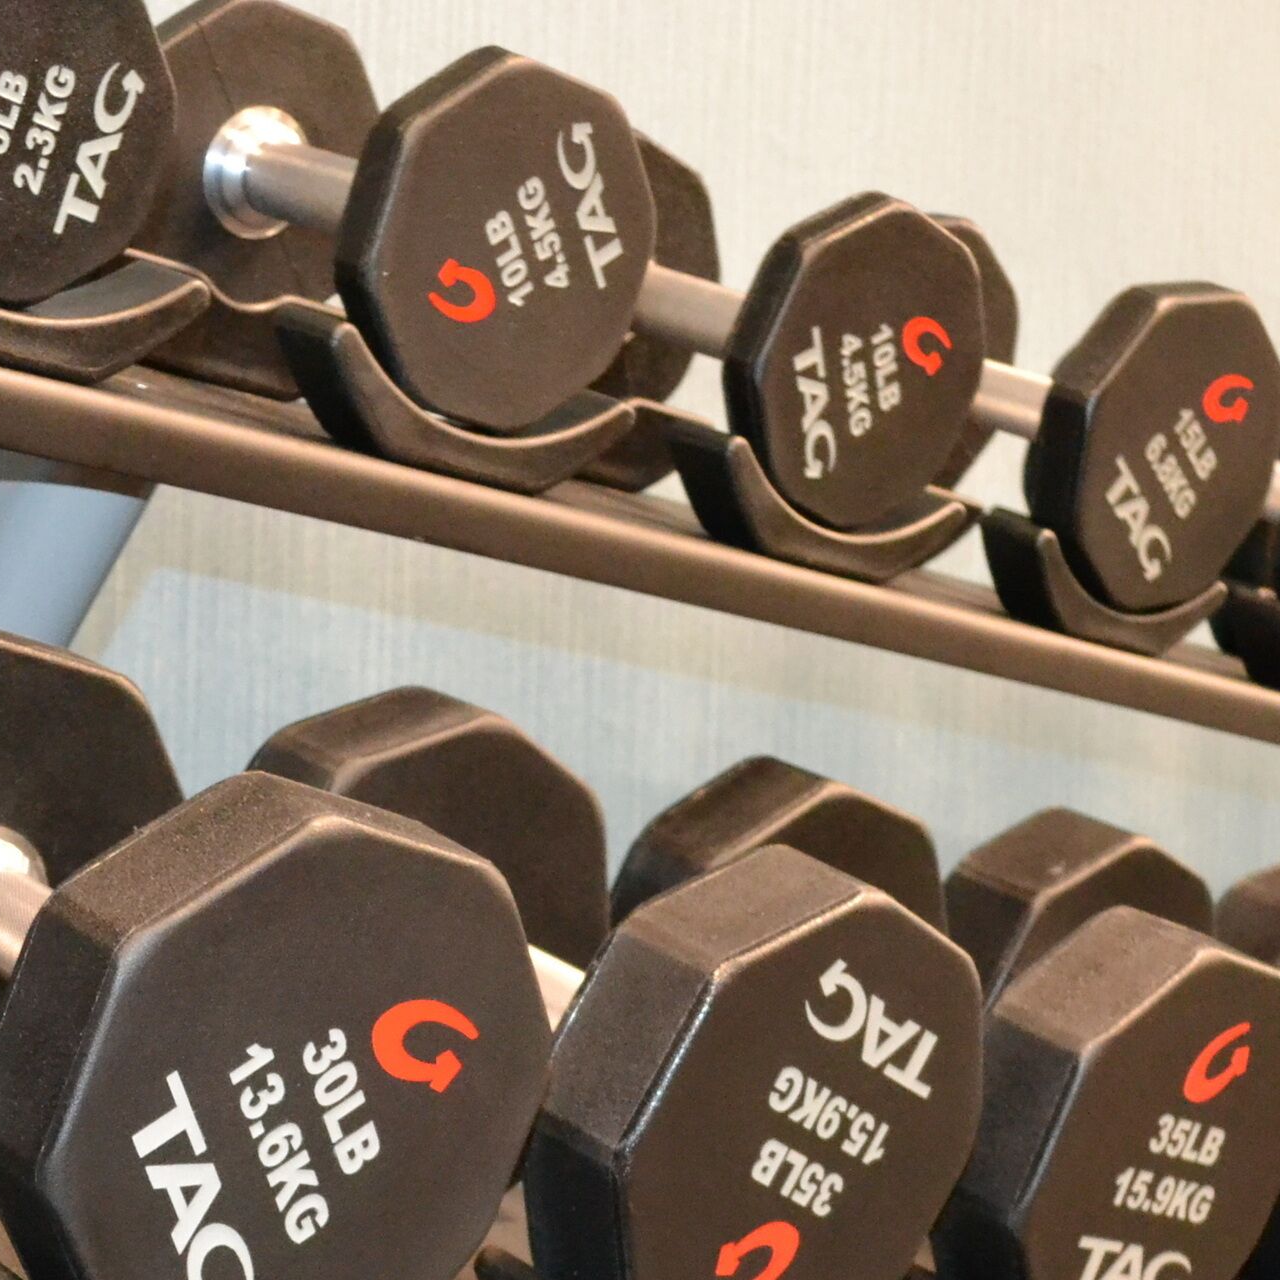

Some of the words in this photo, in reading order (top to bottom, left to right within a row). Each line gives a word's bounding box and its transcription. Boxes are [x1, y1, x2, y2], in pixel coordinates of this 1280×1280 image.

[13, 64, 76, 196] 2.3KG
[52, 61, 146, 235] TAG
[484, 209, 535, 308] 10LB
[516, 175, 570, 289] 4.5KG
[556, 121, 625, 290] TAG
[792, 325, 837, 480] TAG
[839, 333, 873, 437] 4.5KG
[870, 322, 903, 412] 10LB
[1144, 432, 1197, 520] 6.8KG
[1173, 407, 1218, 482] 15LB
[1105, 453, 1172, 583] TAG
[804, 958, 939, 1100] TAG
[228, 1042, 330, 1245] 13.6KG
[302, 1027, 381, 1176] 30LB
[768, 1065, 890, 1166] 15.9KG
[1148, 1112, 1226, 1168] 35LB
[750, 1137, 844, 1217] 35LB
[1112, 1166, 1216, 1226] 15.9KG
